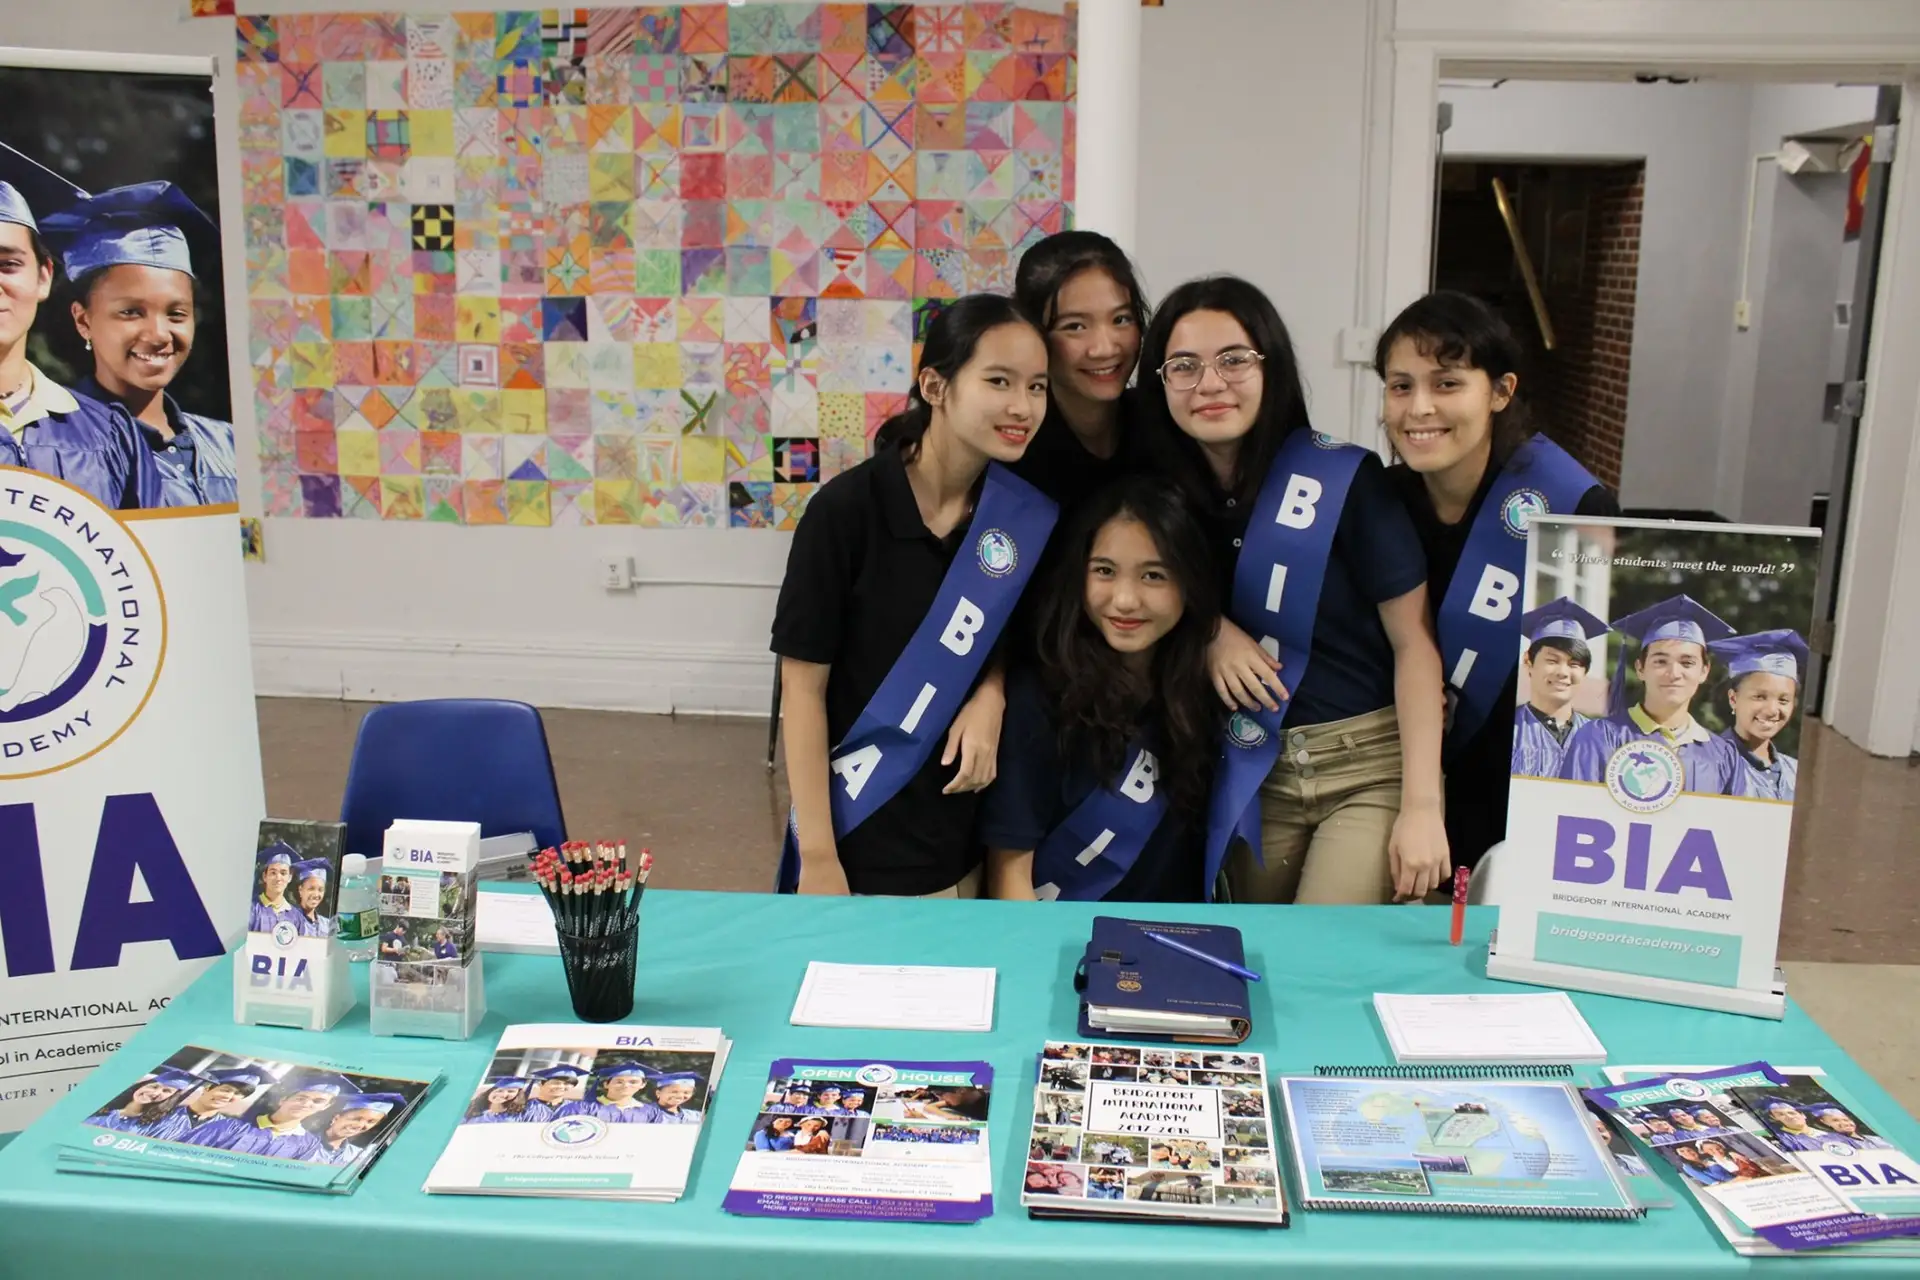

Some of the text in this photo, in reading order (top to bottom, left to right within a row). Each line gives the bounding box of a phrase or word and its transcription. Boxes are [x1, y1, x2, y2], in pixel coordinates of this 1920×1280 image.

[1568, 553, 1608, 565] Where
[1613, 556, 1667, 568] students
[1672, 561, 1703, 570] meet
[1706, 562, 1726, 572] the
[1732, 564, 1776, 574] world!
[409, 849, 433, 863] BIA
[1552, 815, 1734, 901] BIA
[1552, 893, 1731, 920] BRIDGEPORT INTERNATIONAL ACADEMY
[1550, 924, 1721, 956] bridgeportacademy.org
[250, 954, 313, 992] BIA
[14, 1051, 29, 1063] in
[35, 1041, 122, 1060] Academics
[616, 1036, 654, 1047] BIA
[800, 1068, 965, 1084] OPEN HOUSE
[1112, 1087, 1196, 1100] BRIDGEPORT
[1620, 1074, 1767, 1103] OPEN HOUSE
[1102, 1098, 1204, 1112] INTERNATIONAL
[1119, 1111, 1188, 1123] ACADEMY
[113, 1138, 148, 1154] BIA
[1819, 1163, 1919, 1186] BIA
